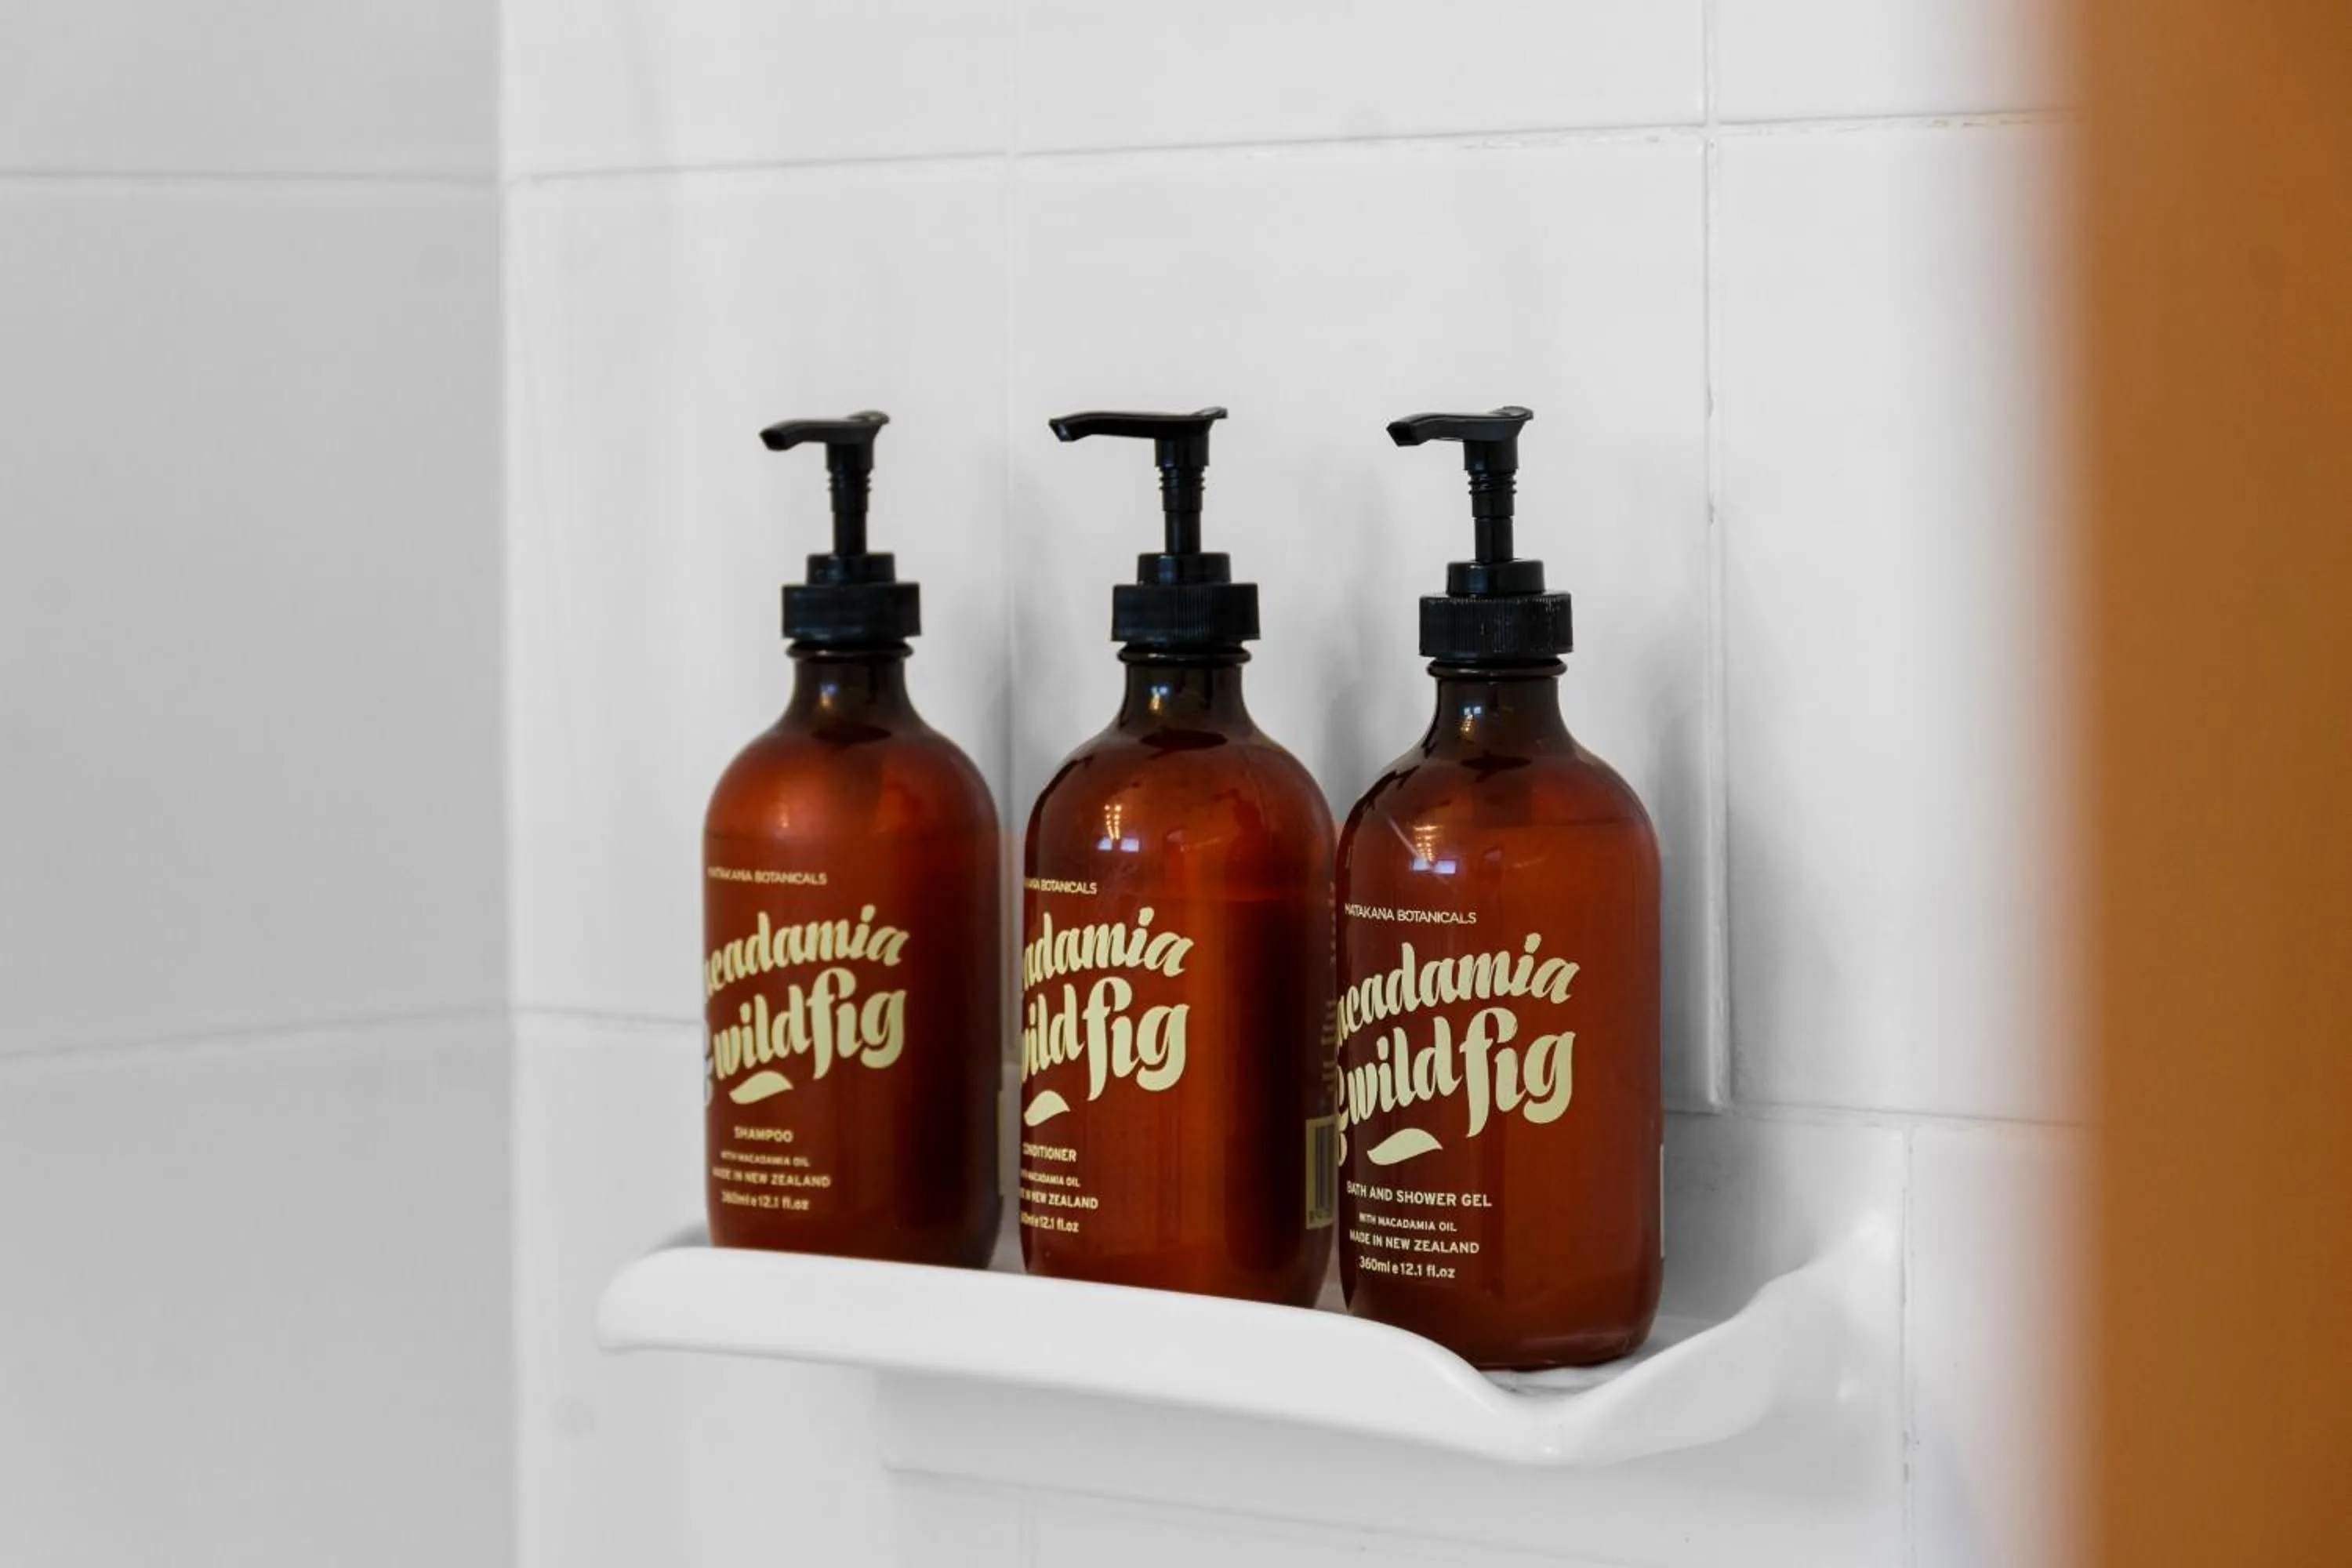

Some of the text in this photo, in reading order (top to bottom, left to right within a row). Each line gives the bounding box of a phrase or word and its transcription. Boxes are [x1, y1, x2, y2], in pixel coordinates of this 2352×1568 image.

[754, 869, 827, 885] BOTANICALS
[1396, 909, 1477, 924] BOTANICALS
[706, 904, 909, 999] cadamia
[1337, 932, 1581, 1047] acadamia
[734, 1125, 793, 1143] SHAMPOO
[745, 1171, 768, 1185] NEW
[771, 1173, 831, 1189] ZEALAND
[1048, 1192, 1098, 1210] ZEALAND
[1346, 1180, 1493, 1207] BATH AND SHOWER GEL
[1359, 1212, 1457, 1232] WITH MACADAMIA OIL
[1349, 1229, 1479, 1254] MADE IN NEW ZEALAND
[1359, 1255, 1390, 1273] 360ml
